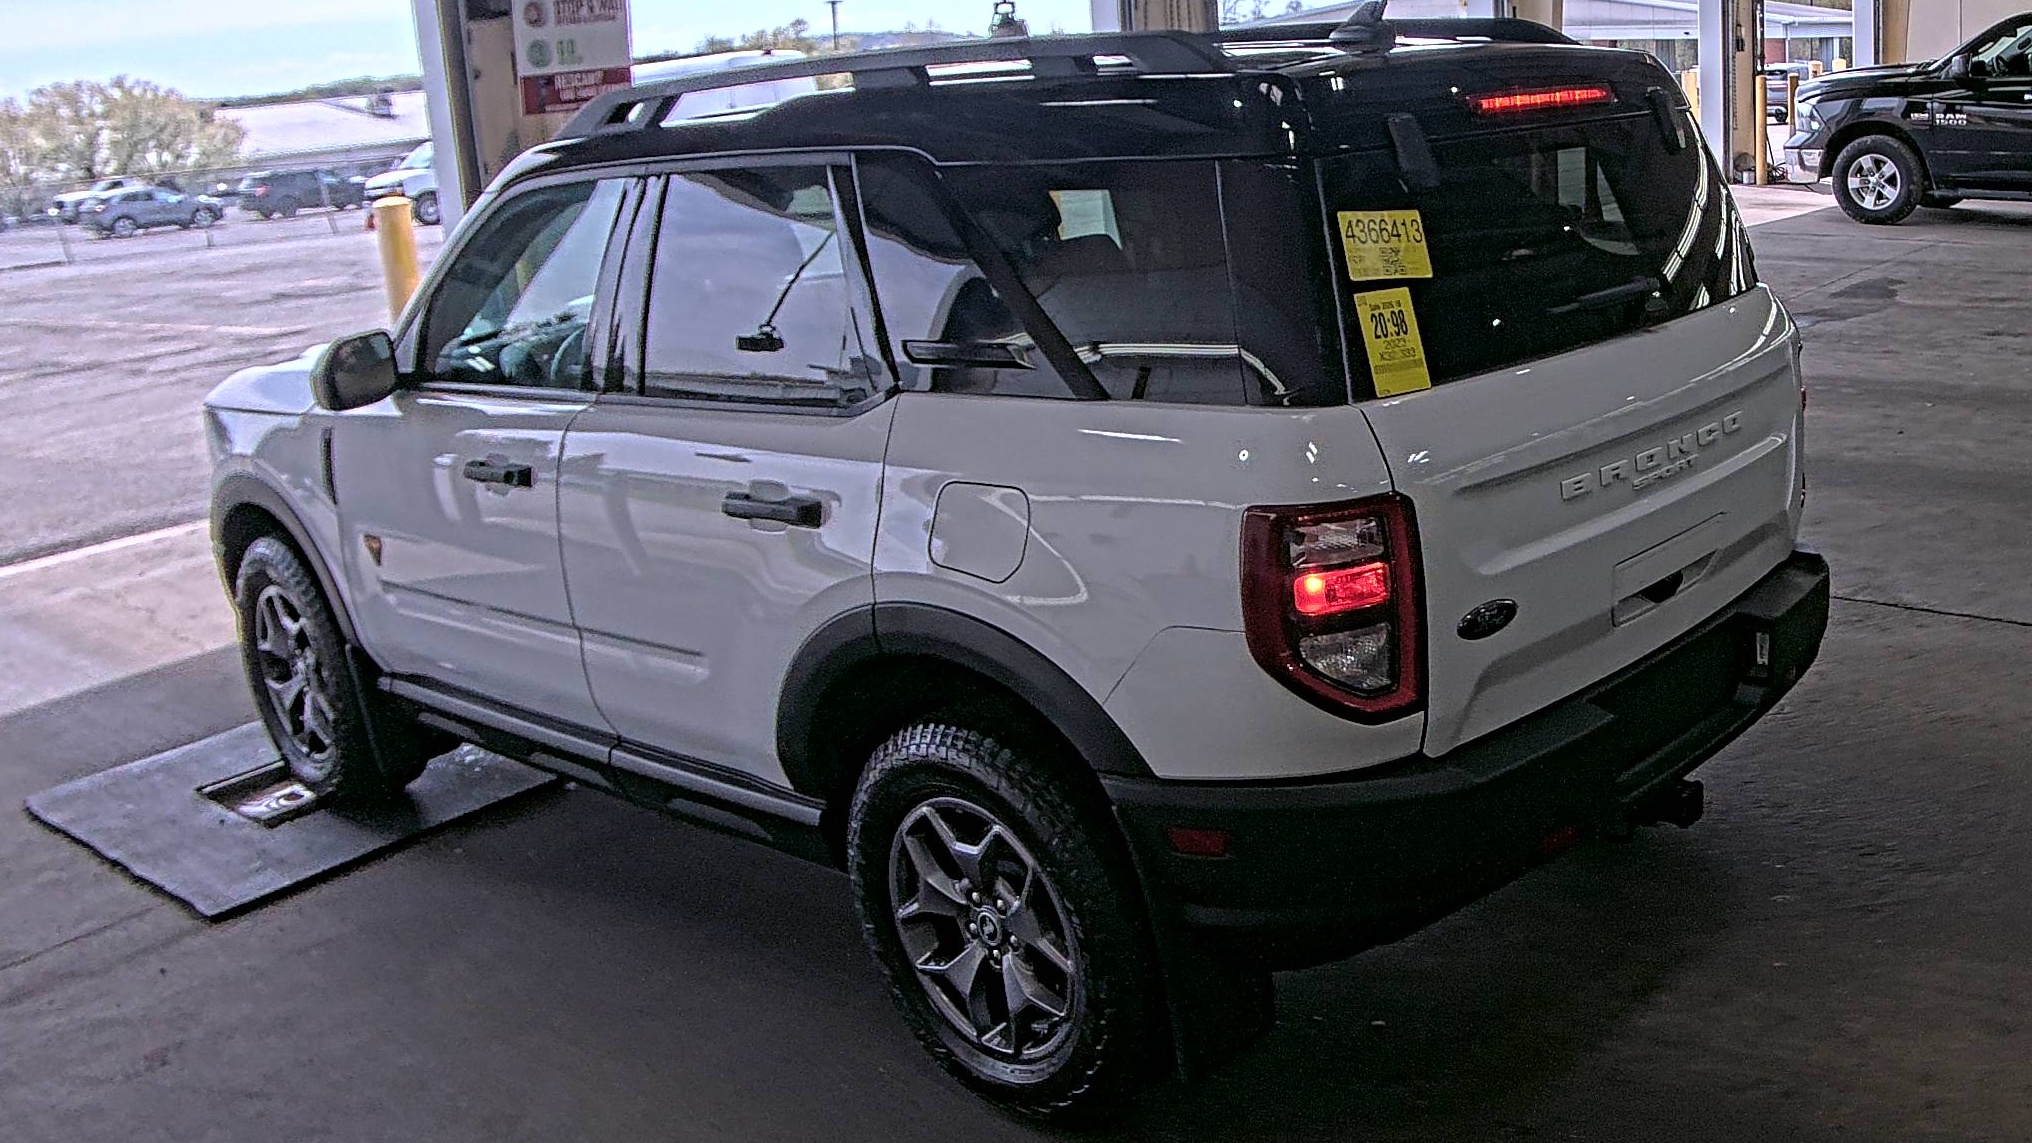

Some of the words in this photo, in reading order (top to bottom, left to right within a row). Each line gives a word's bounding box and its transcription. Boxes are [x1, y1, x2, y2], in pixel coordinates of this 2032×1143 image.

[1935, 112, 1967, 120] RAM
[1345, 218, 1423, 244] 4366413
[1370, 309, 1409, 339] 20:98
[1560, 410, 1743, 500] BRONCO
